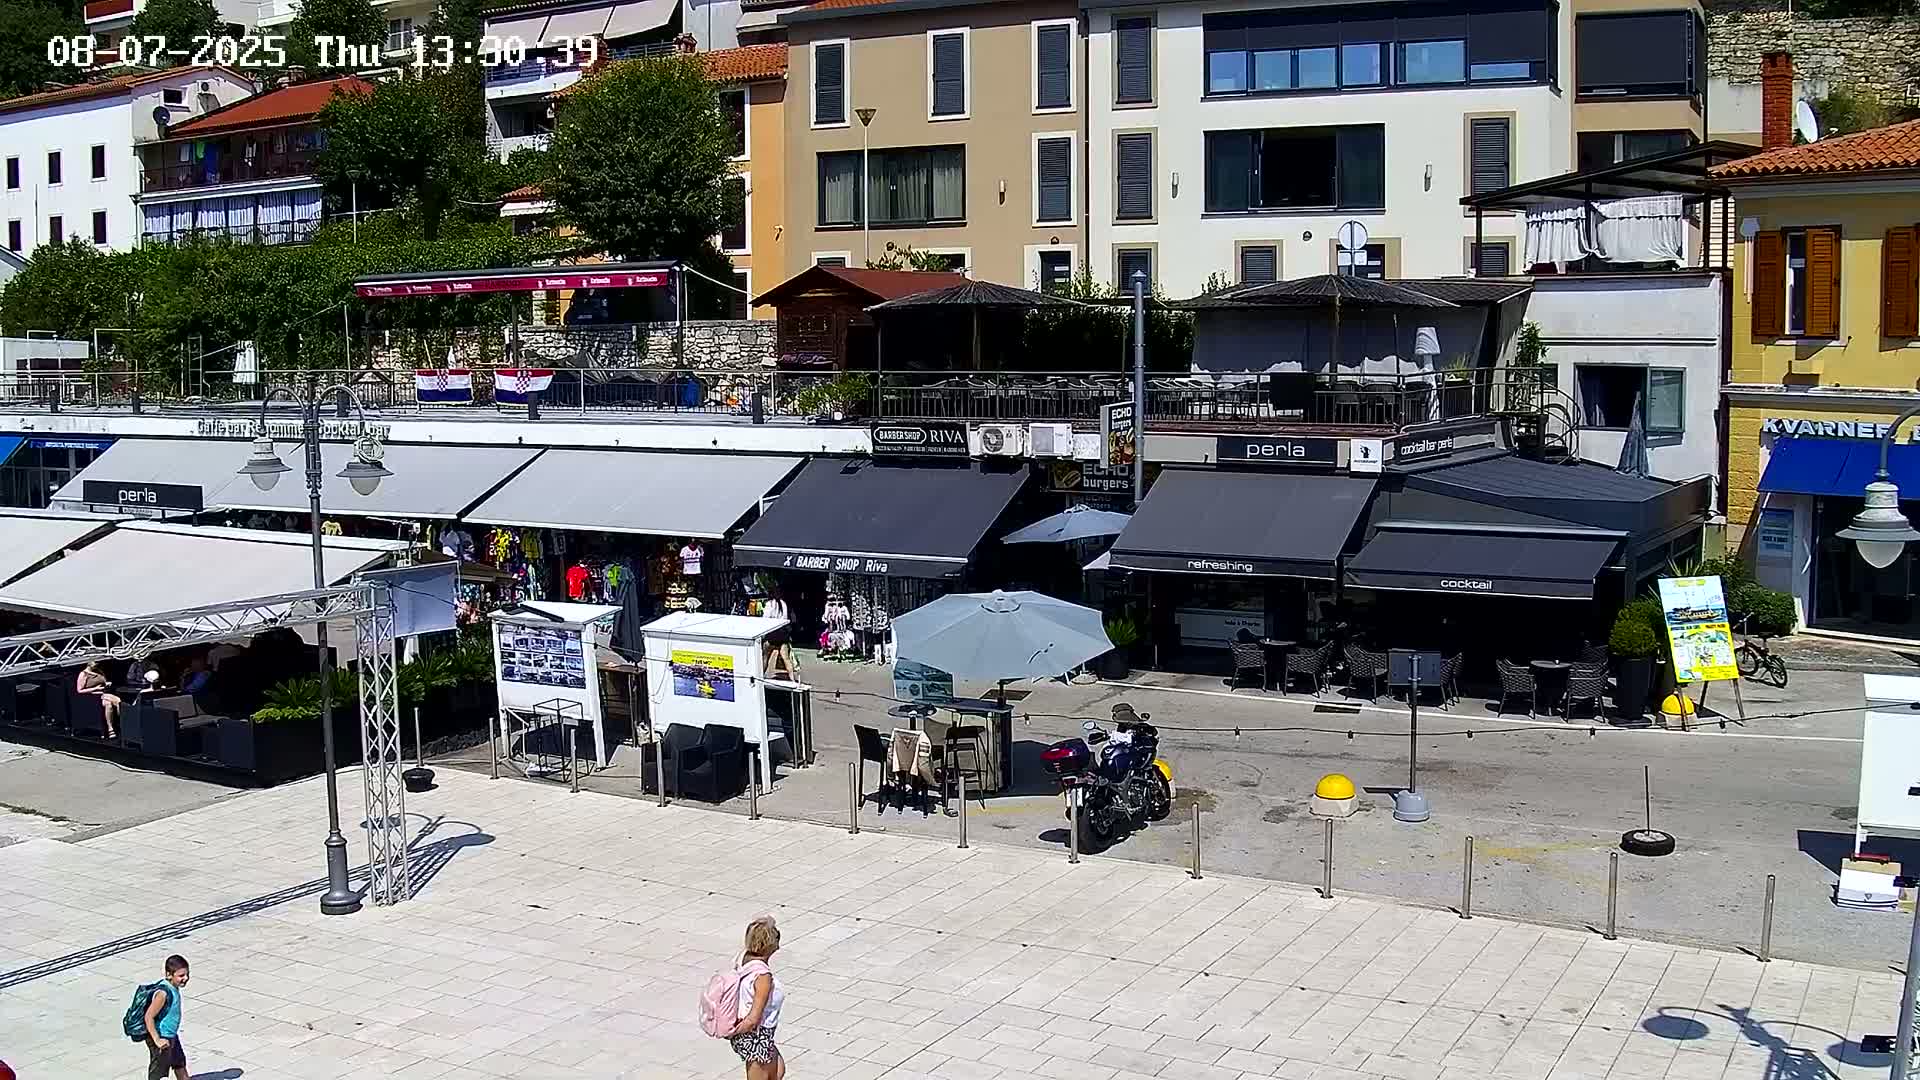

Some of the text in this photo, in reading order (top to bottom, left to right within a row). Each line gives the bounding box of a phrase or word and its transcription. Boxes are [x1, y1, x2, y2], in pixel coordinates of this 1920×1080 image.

[1111, 407, 1131, 419] ECHO
[929, 429, 965, 444] RIVA
[1246, 441, 1305, 459] perla
[1083, 476, 1129, 490] burgers
[118, 487, 157, 503] perla
[796, 555, 888, 572] BARBER SHOP Riva
[1187, 559, 1253, 573] refreshing
[1440, 579, 1493, 590] cocktail
